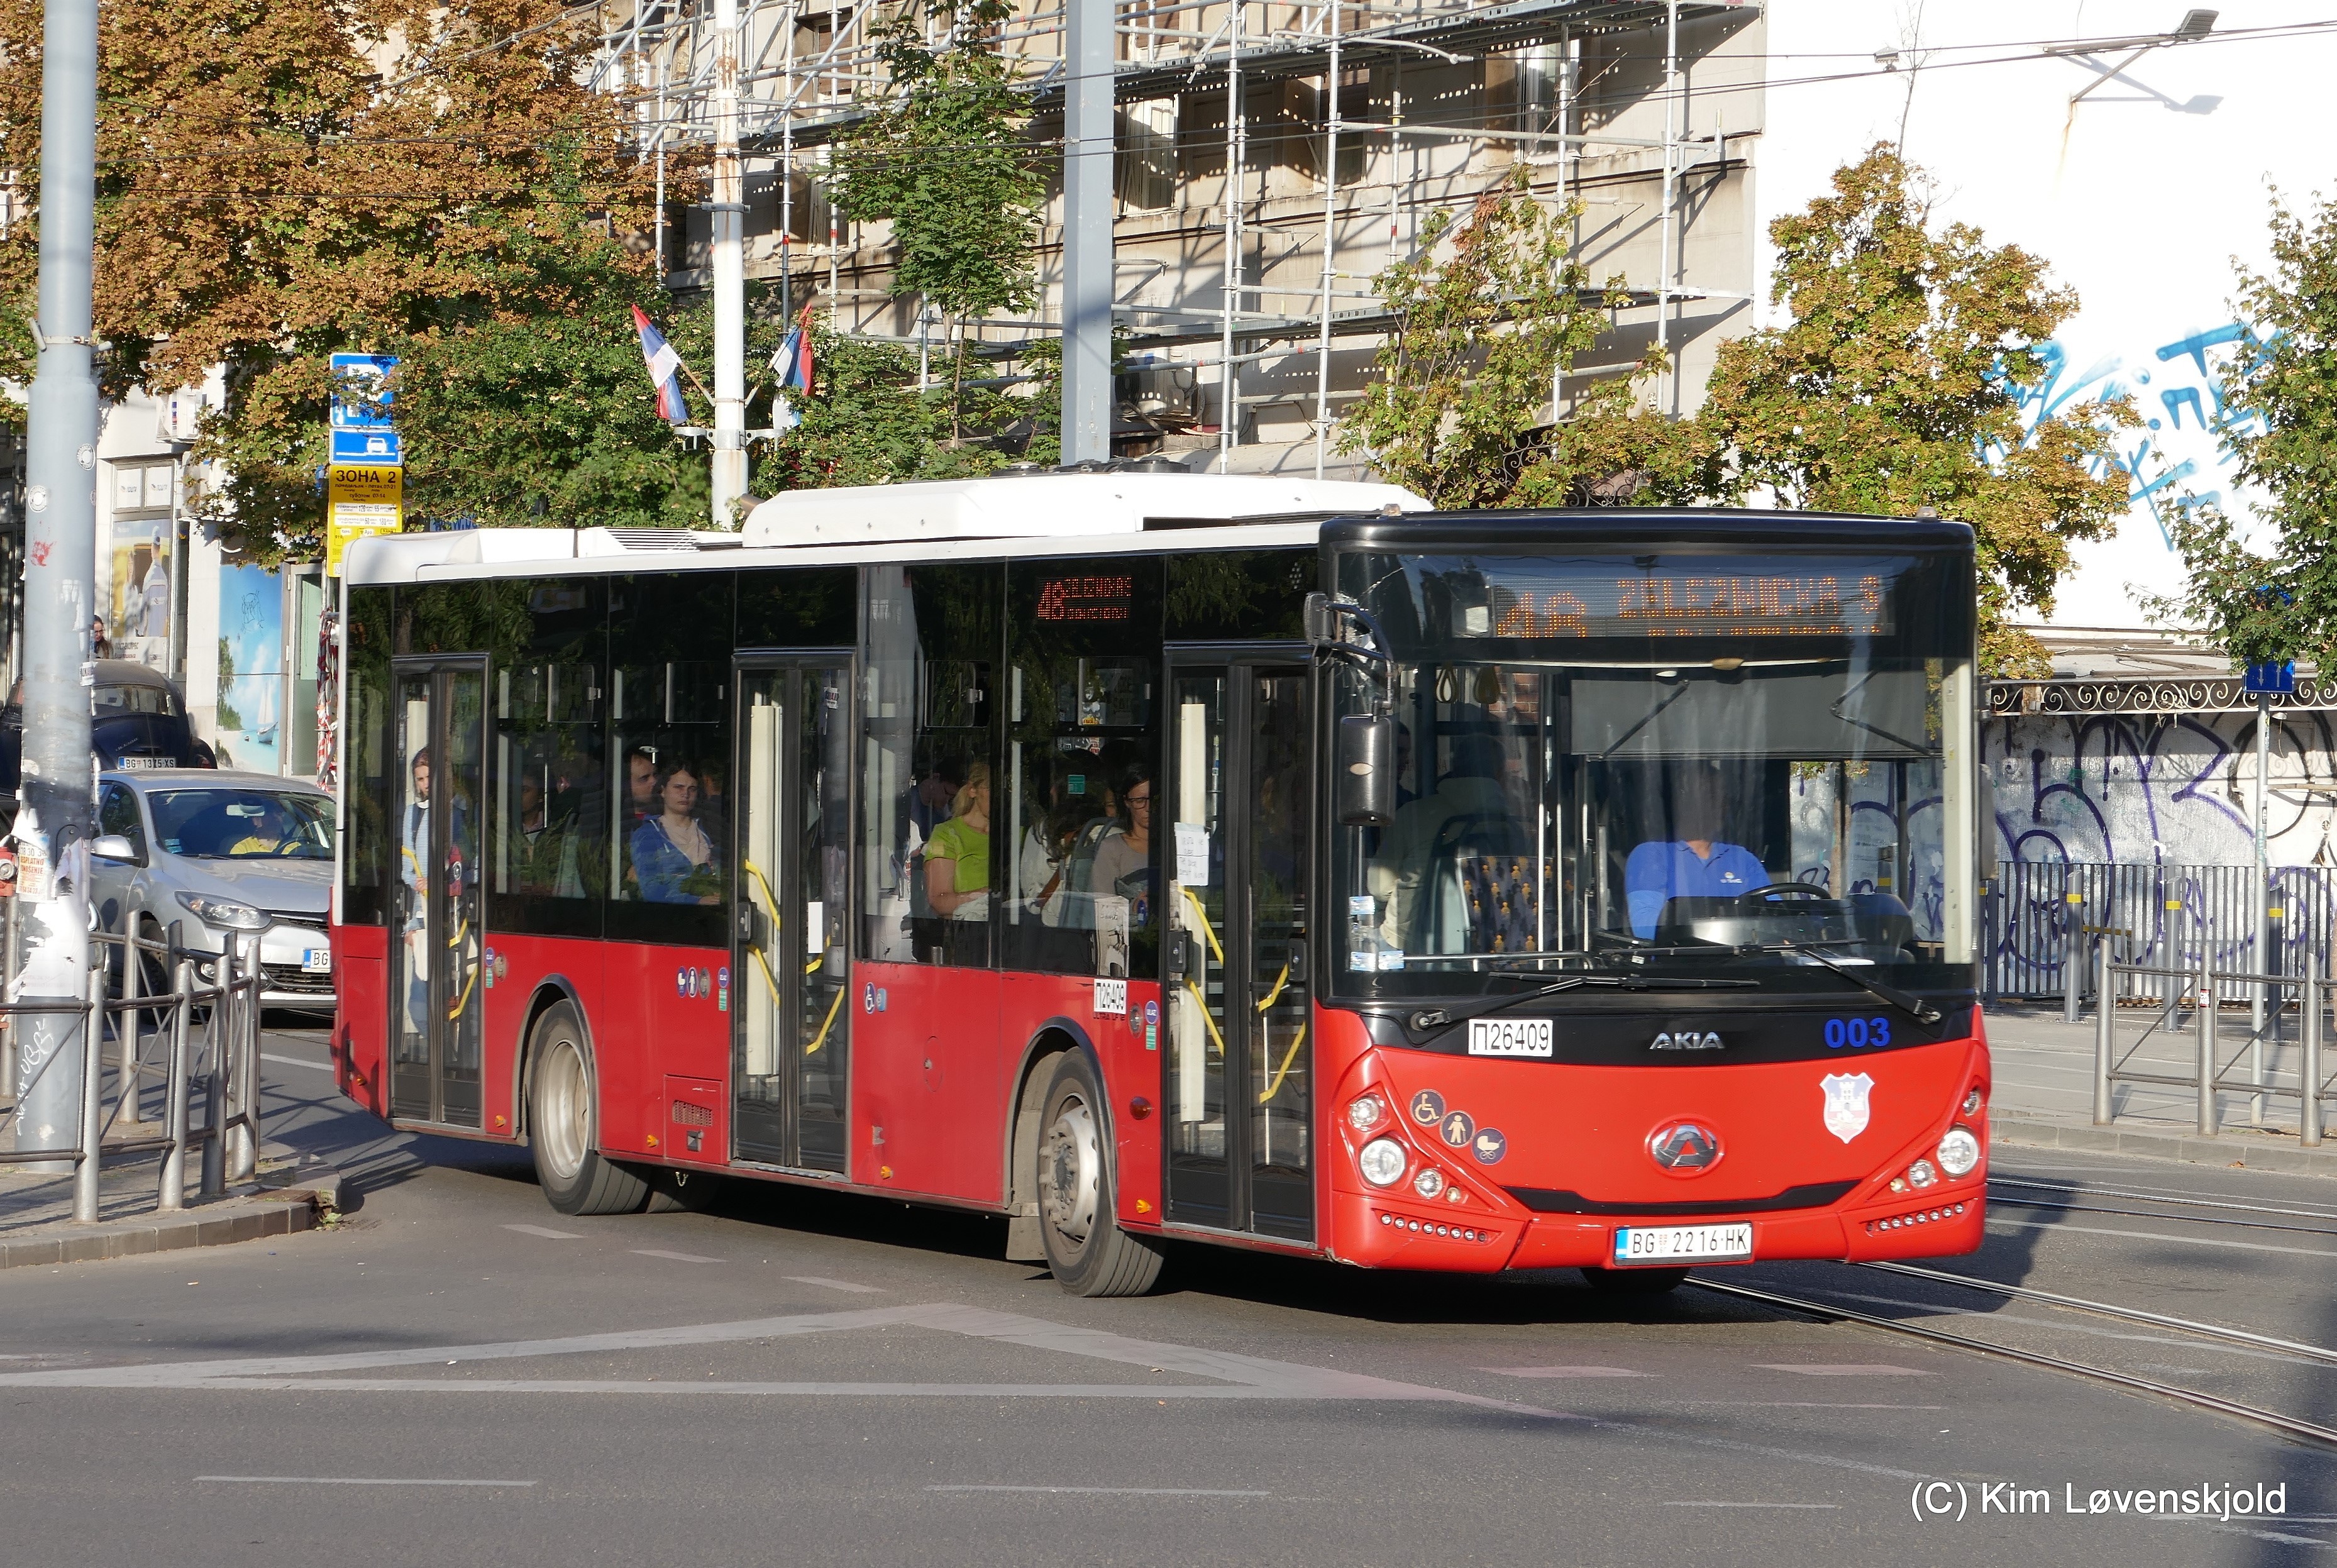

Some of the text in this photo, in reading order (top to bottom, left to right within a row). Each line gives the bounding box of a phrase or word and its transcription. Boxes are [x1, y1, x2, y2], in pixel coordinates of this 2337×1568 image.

[336, 470, 396, 483] ЗОНА 2
[1037, 581, 1064, 621] 48
[1616, 577, 1839, 617] ZELEZNICKA
[126, 759, 136, 768] BG
[314, 952, 329, 966] BG
[1096, 982, 1124, 1010] П26409
[1472, 1022, 1549, 1051] П26409
[1649, 1031, 1725, 1050] AKIA
[1824, 1017, 1892, 1049] 003
[1632, 1232, 1655, 1254] BG
